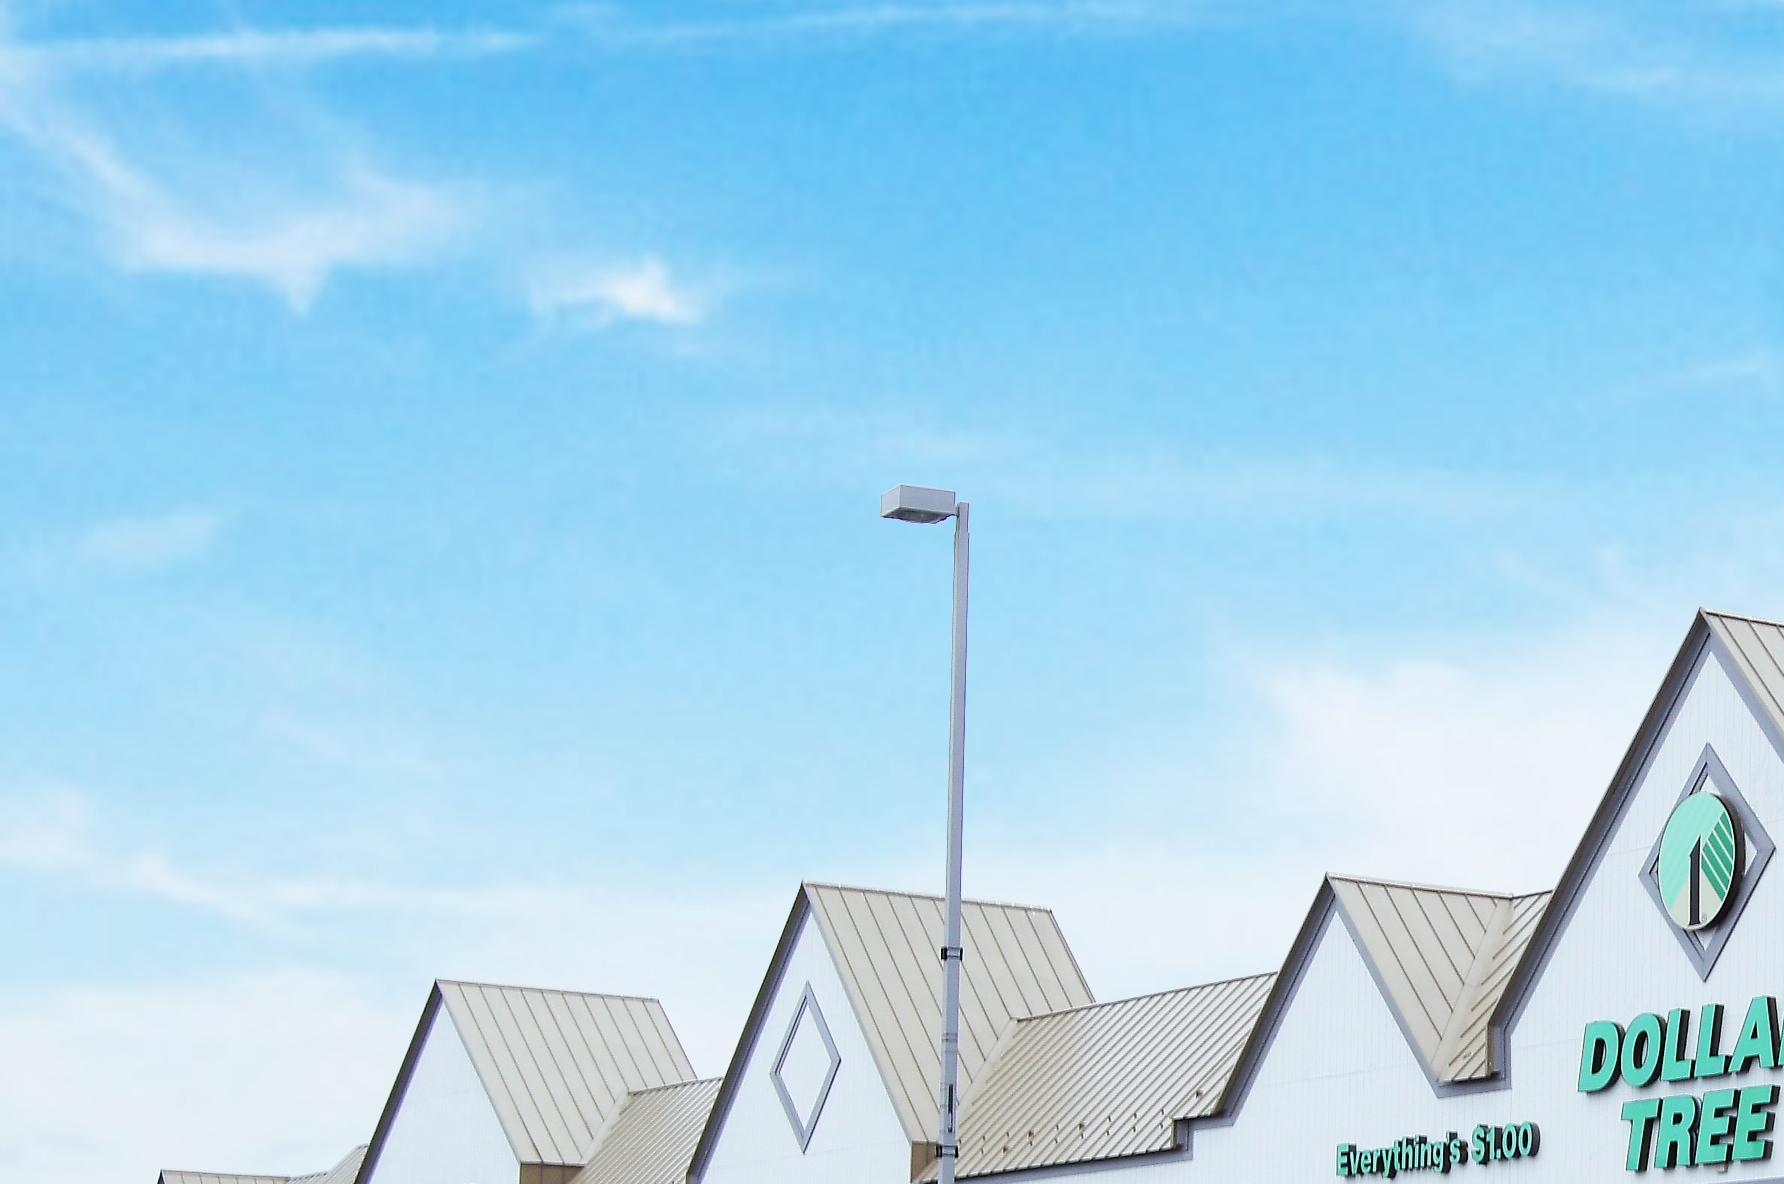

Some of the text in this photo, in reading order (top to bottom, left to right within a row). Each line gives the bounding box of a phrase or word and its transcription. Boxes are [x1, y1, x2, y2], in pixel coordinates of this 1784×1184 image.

[1336, 1121, 1541, 1179] Everything's $1.00
[1620, 1084, 1781, 1172] TREE
